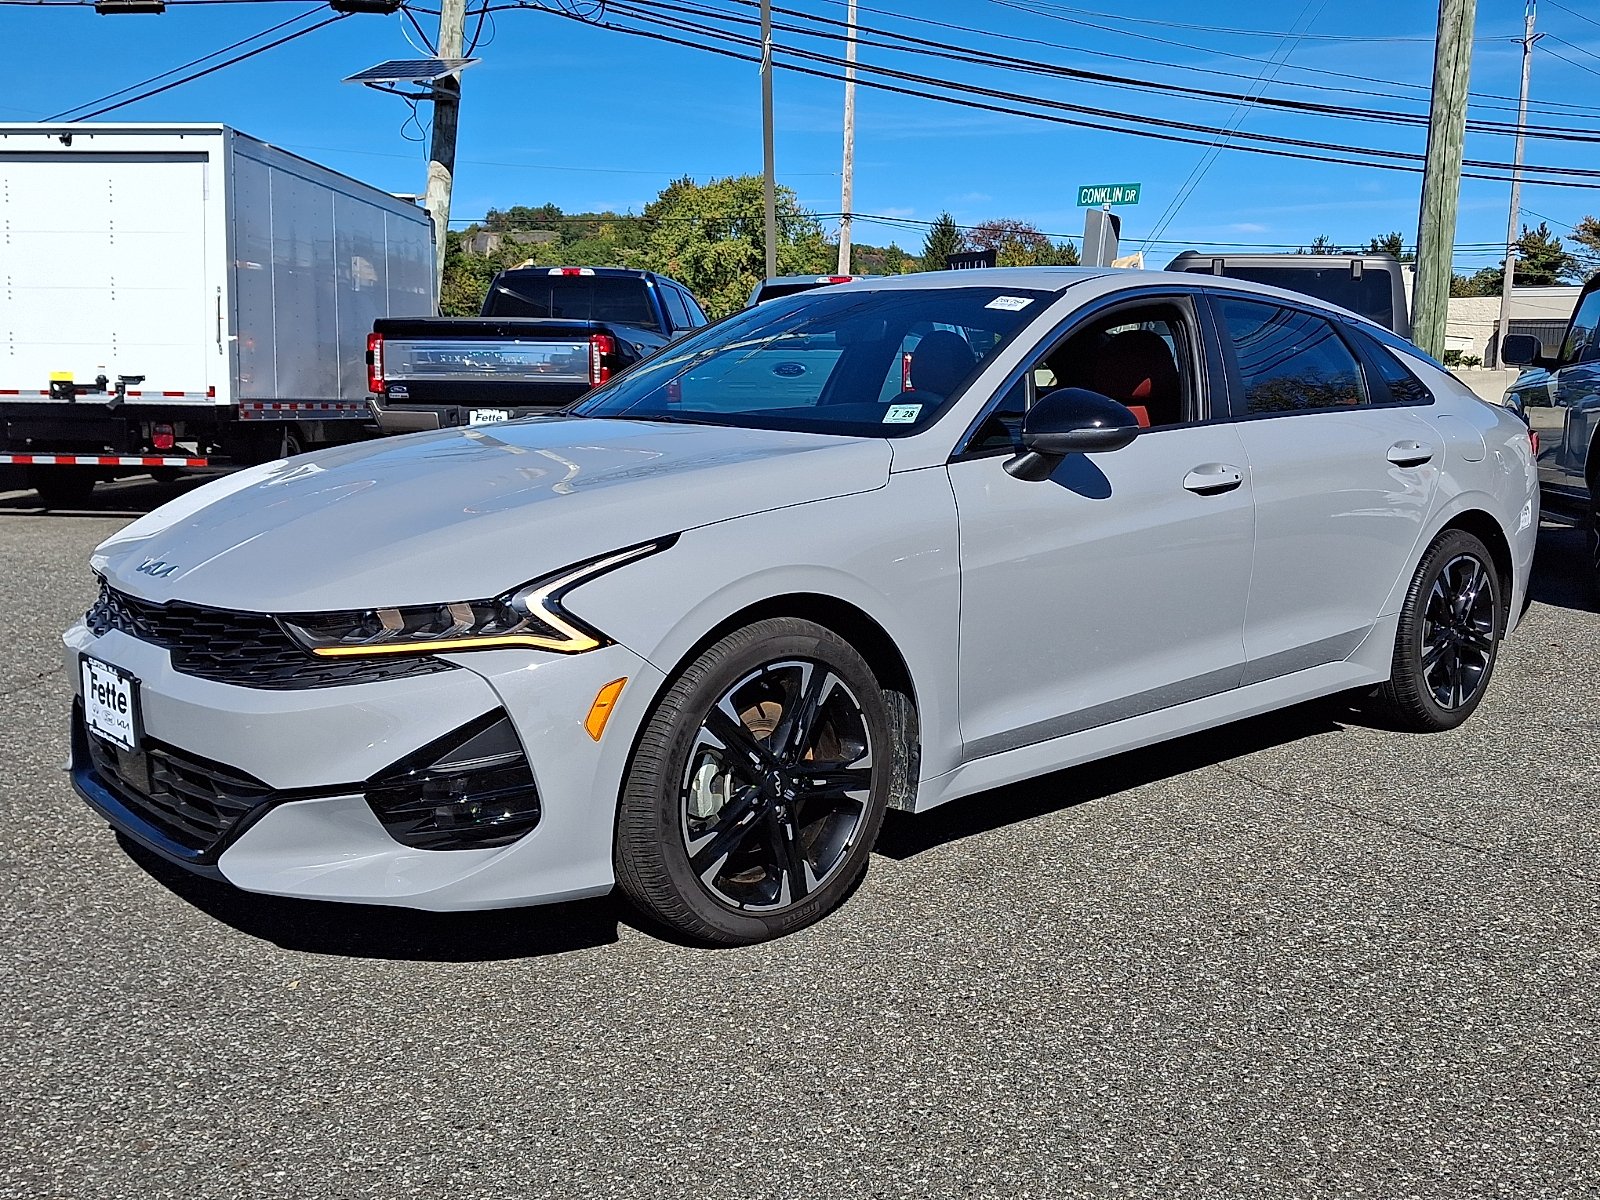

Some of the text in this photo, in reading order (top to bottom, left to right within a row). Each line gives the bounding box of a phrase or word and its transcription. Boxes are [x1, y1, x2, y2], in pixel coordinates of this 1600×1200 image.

[1081, 186, 1137, 204] CONKLIN DR
[475, 413, 503, 422] Fette
[891, 409, 916, 418] 7 28
[90, 671, 128, 715] Fette
